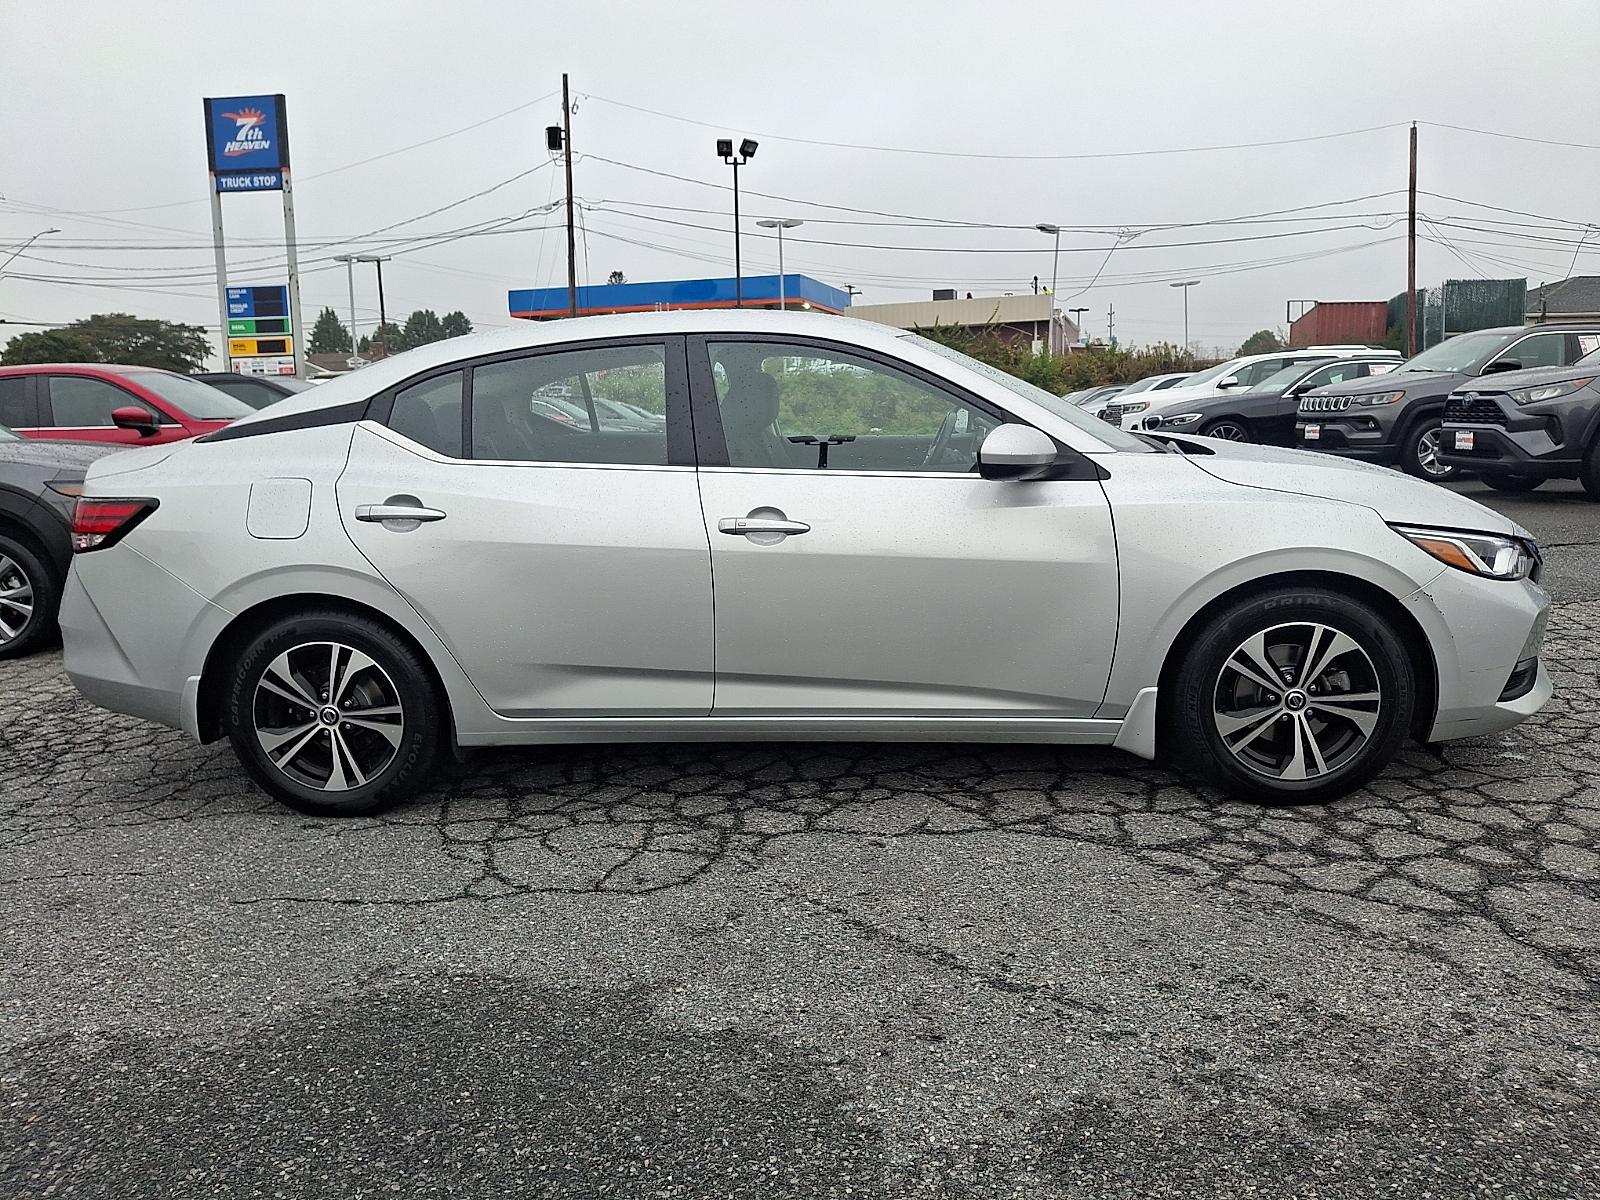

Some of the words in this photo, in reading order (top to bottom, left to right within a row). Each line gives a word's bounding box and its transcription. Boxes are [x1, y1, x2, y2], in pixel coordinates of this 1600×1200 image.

[236, 118, 263, 141] 7th
[224, 141, 270, 152] HEAVEN
[221, 177, 252, 188] TRUCK
[253, 175, 277, 187] STOP
[231, 641, 265, 726] CAPRICORN
